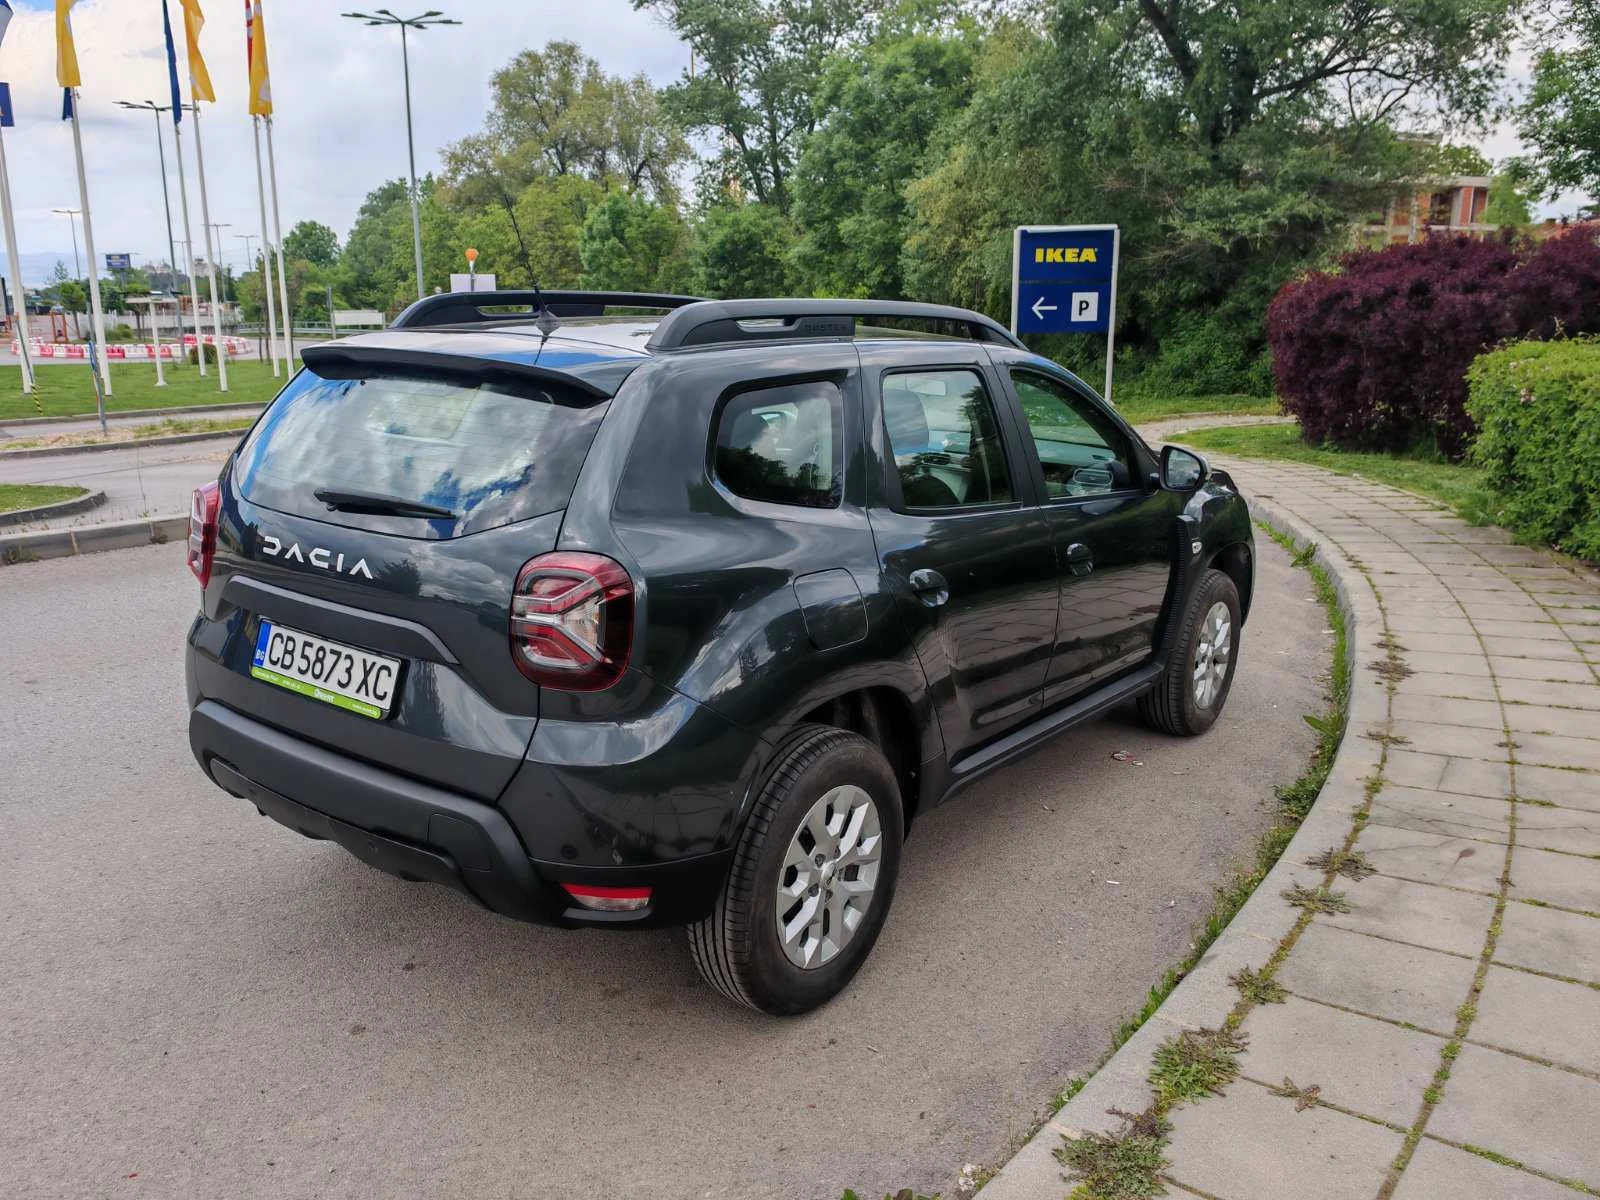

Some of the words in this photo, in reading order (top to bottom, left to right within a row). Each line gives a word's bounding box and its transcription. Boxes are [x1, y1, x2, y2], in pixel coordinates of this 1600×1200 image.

[1035, 248, 1097, 263] IKEA
[1079, 300, 1090, 316] P
[262, 535, 373, 579] DACIA
[255, 649, 266, 660] BG
